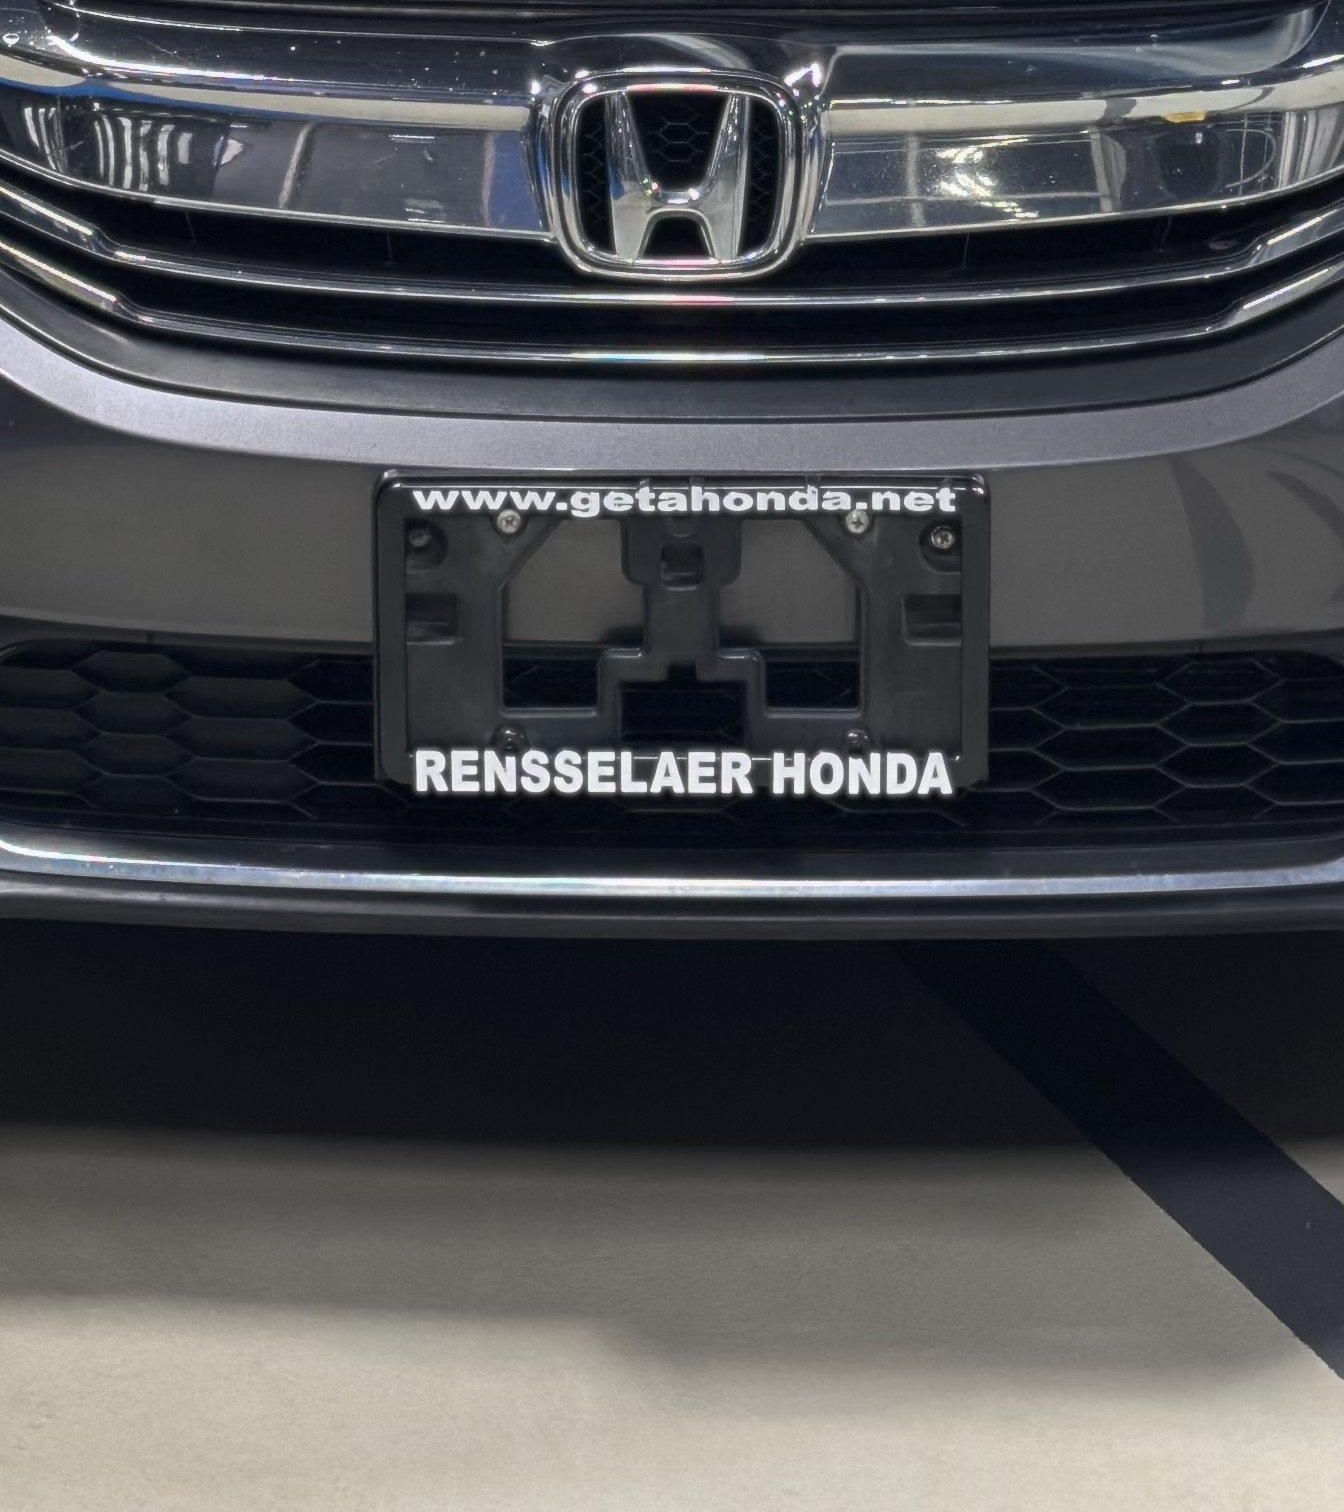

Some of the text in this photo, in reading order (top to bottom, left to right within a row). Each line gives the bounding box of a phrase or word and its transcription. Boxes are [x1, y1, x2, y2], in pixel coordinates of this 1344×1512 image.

[412, 486, 957, 517] www.getahonda.net
[415, 750, 954, 795] RENSSELAER HONDA
